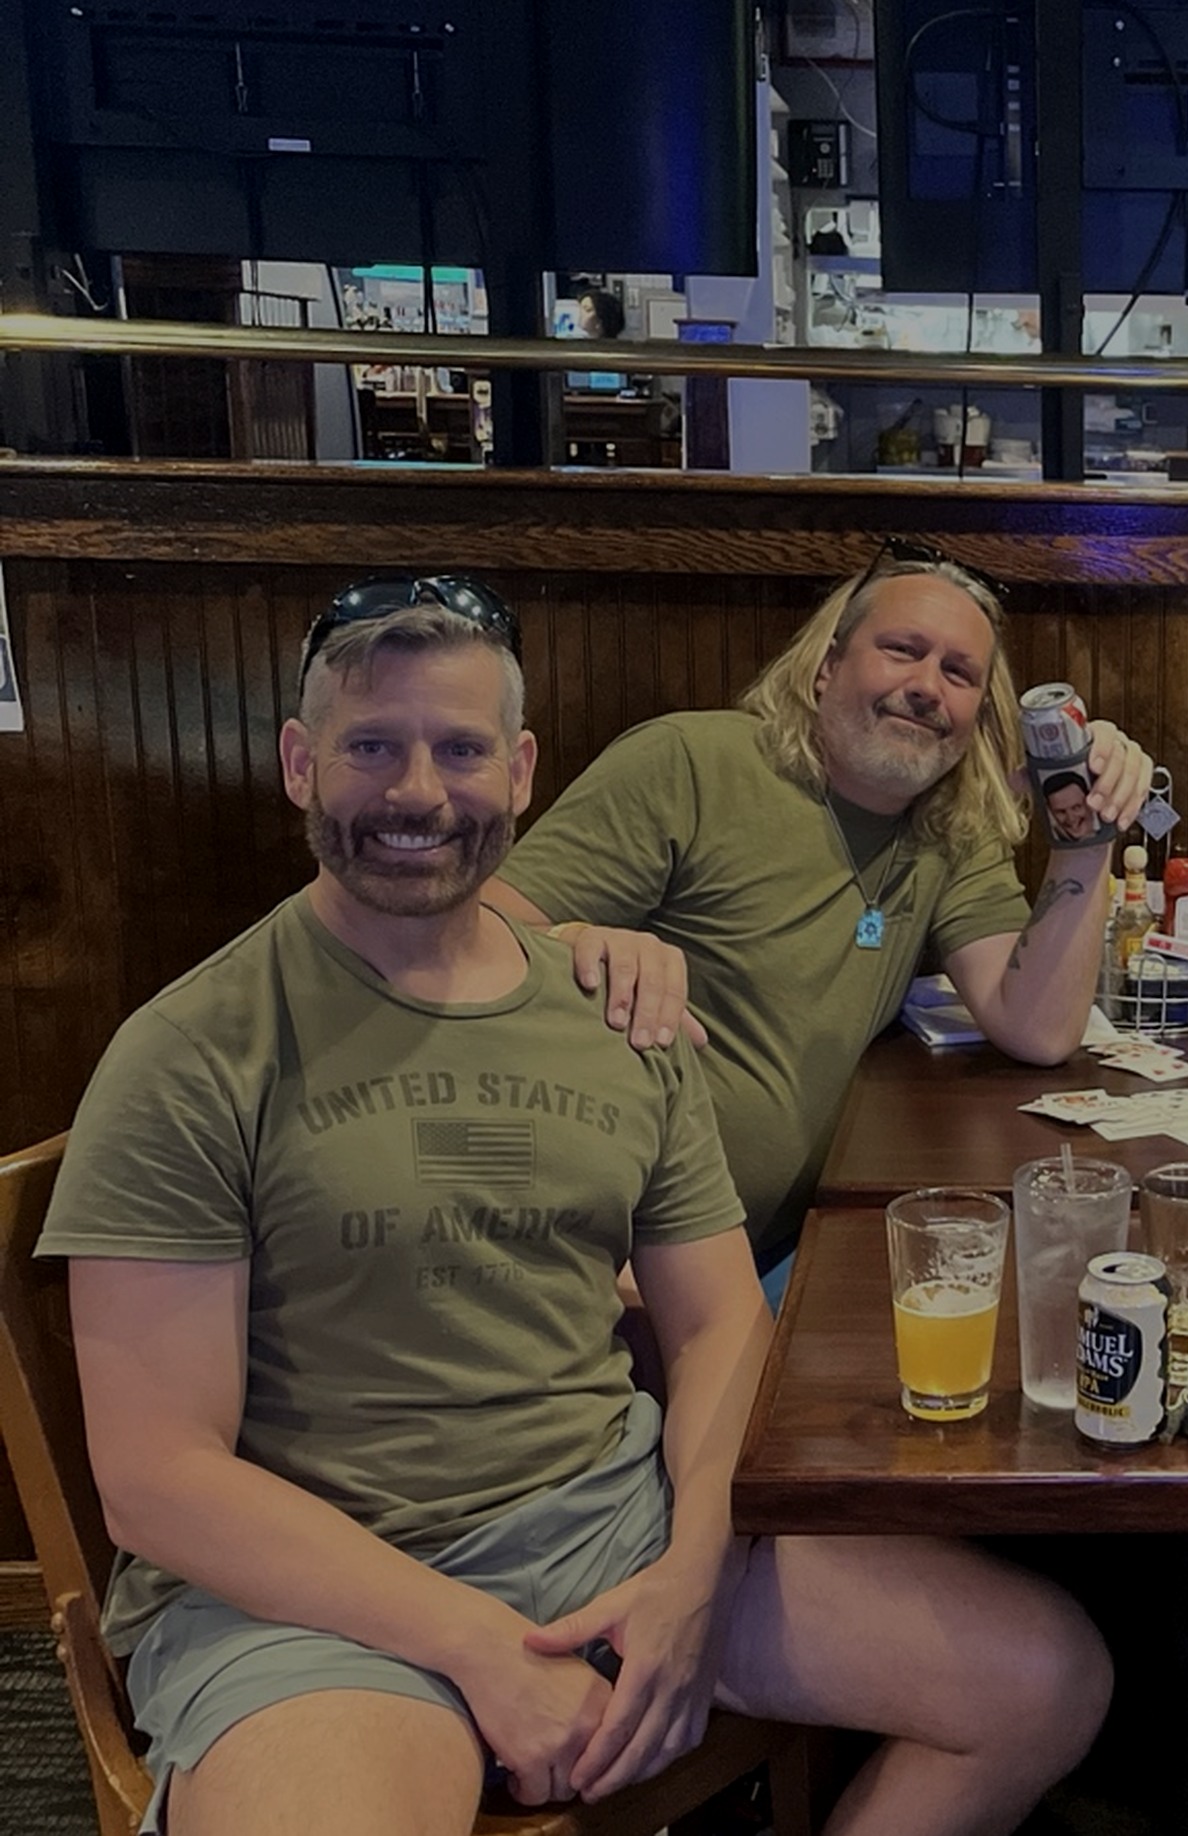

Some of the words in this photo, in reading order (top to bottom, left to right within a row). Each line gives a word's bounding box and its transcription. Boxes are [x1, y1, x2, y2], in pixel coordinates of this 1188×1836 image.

[296, 1071, 457, 1136] UNITED
[477, 1071, 621, 1136] STATES
[339, 1207, 401, 1250] OF
[415, 1264, 461, 1290] EST
[1078, 1325, 1134, 1359] MUEL
